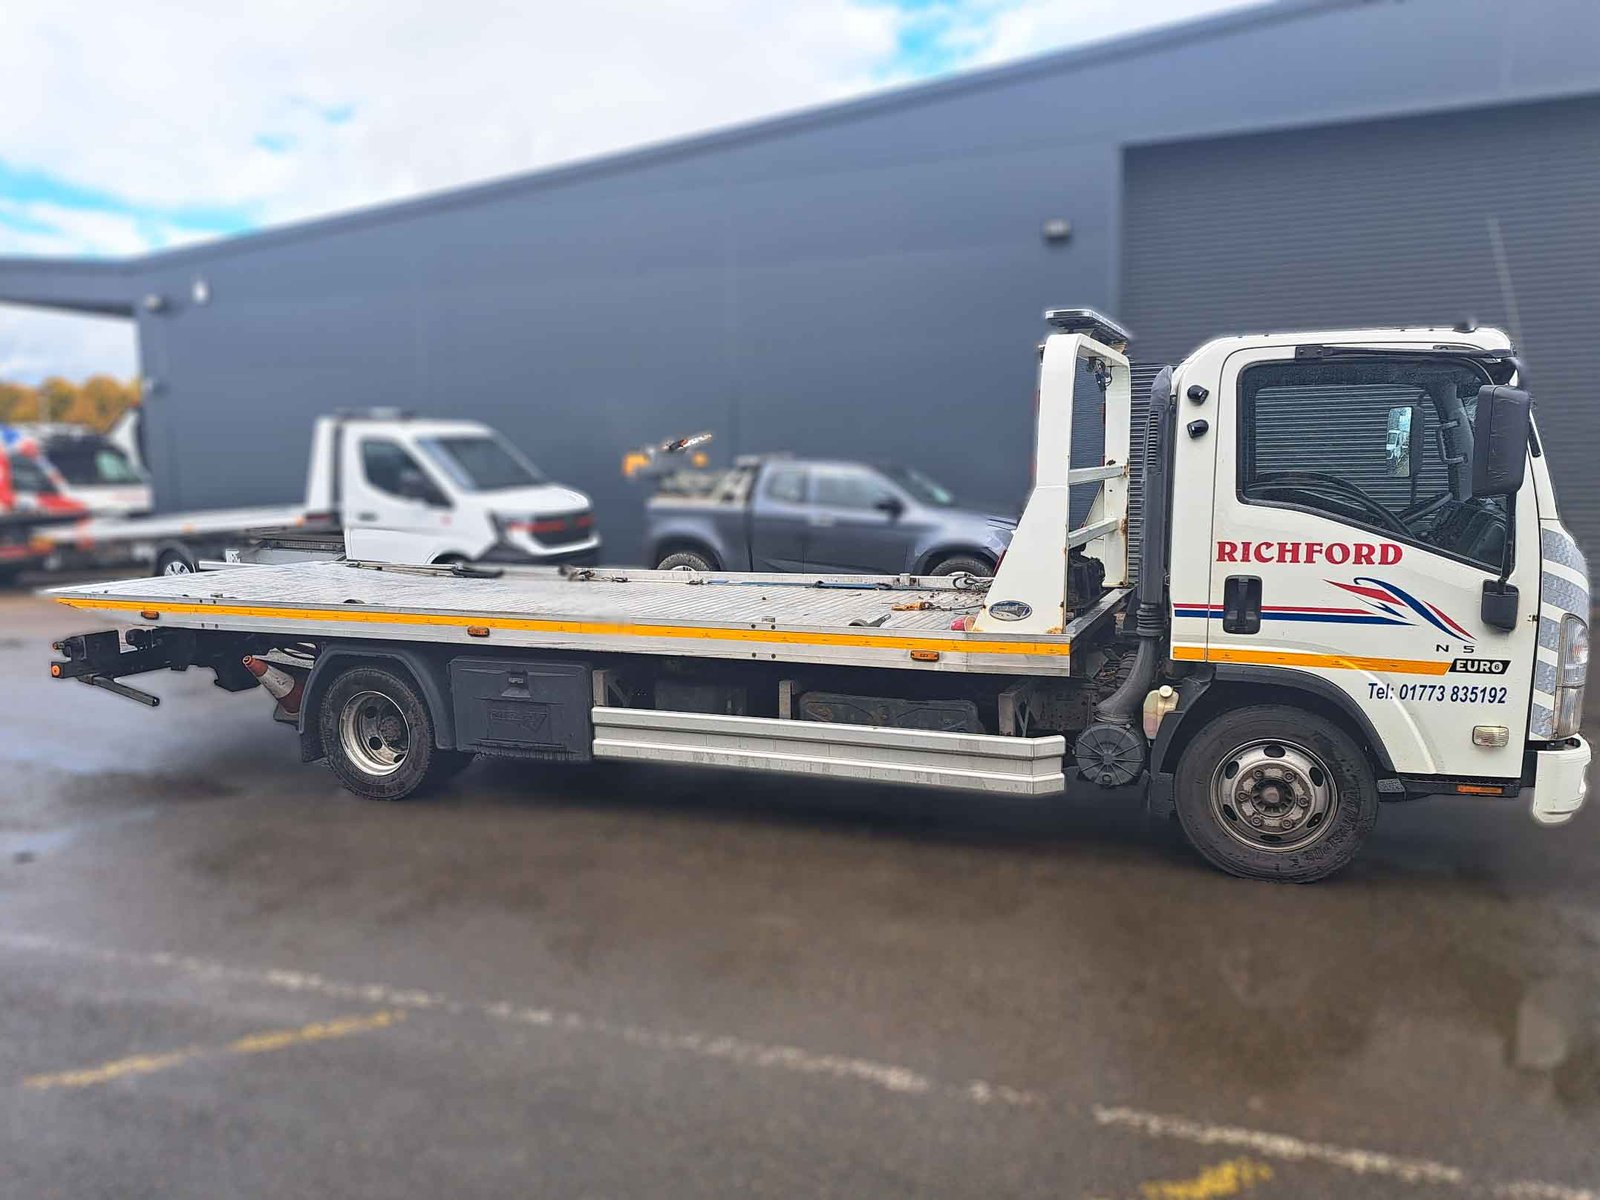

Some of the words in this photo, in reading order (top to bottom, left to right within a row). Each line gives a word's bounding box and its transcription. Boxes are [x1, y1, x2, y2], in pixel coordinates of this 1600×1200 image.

[1216, 541, 1403, 565] RICHFORD
[1368, 683, 1395, 700] Tel:
[1400, 684, 1446, 702] 01773
[1450, 685, 1508, 704] 835192
